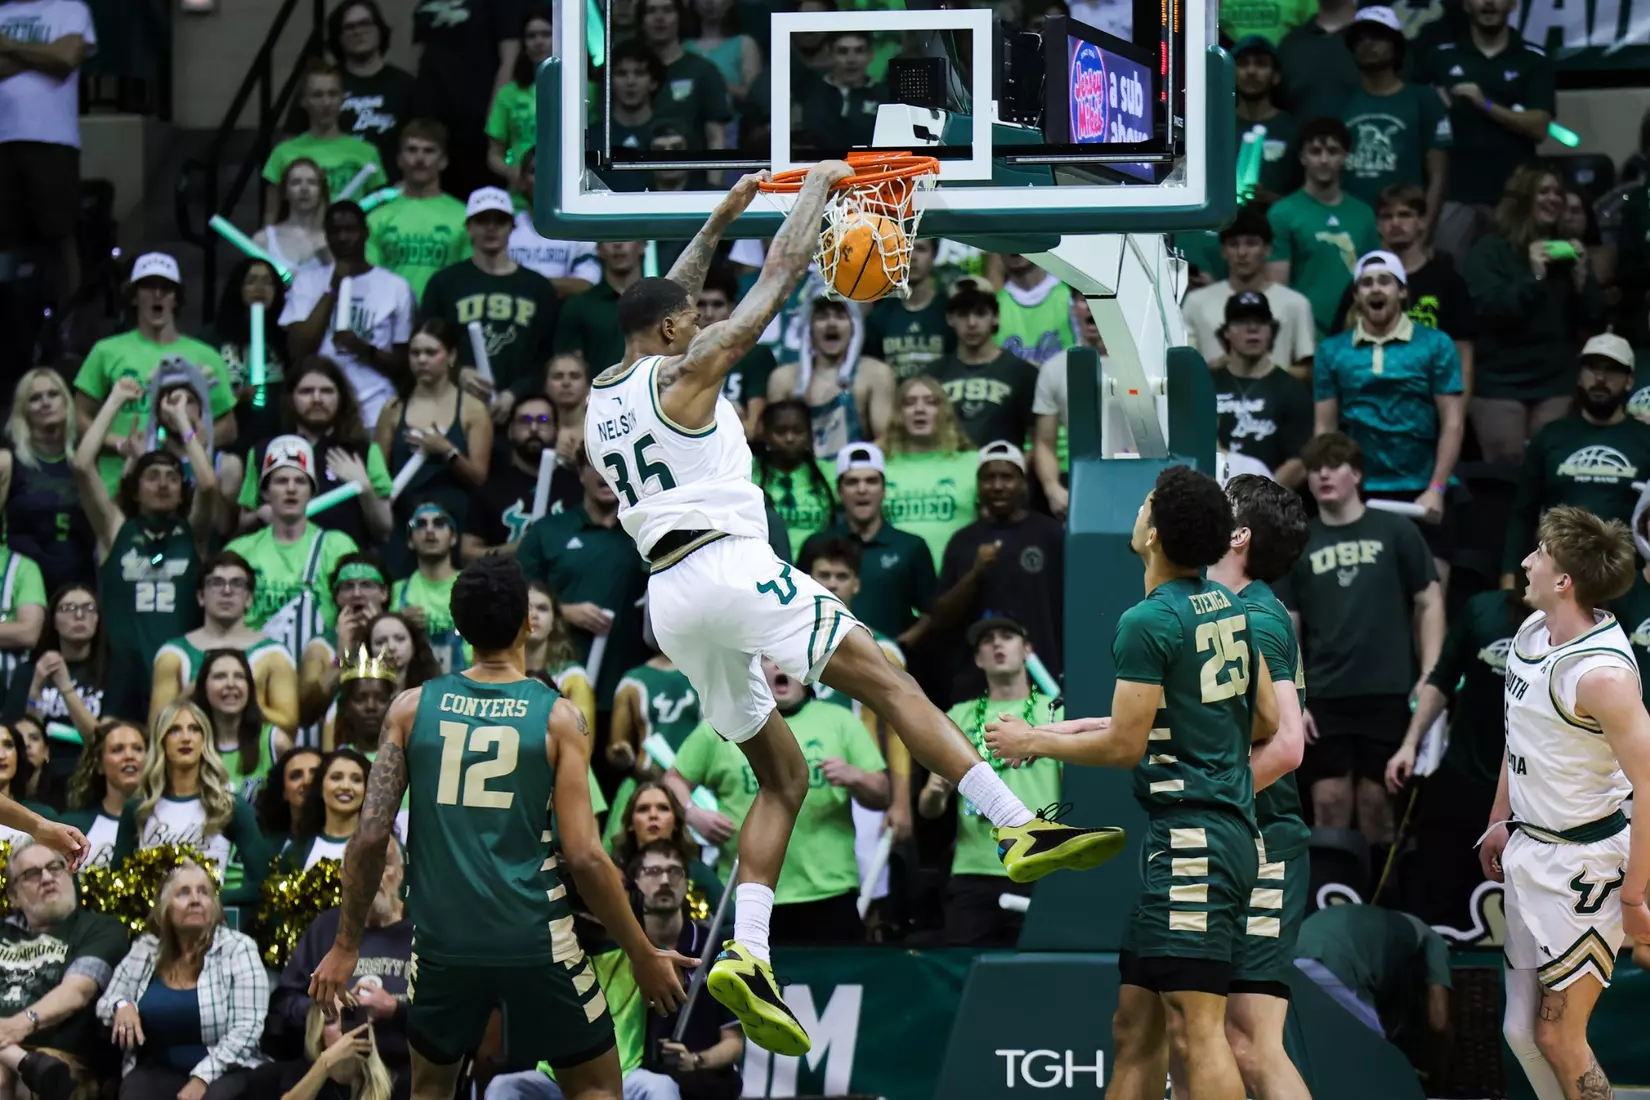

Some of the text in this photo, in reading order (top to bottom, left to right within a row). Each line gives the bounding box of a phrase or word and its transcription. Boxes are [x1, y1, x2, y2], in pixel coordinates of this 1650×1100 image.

[1109, 70, 1143, 118] a sub
[456, 293, 537, 325] USF
[1309, 539, 1384, 575] USF
[135, 581, 176, 613] 22
[1195, 613, 1250, 704] 25
[440, 692, 529, 718] CONYERS
[436, 719, 520, 810] 12
[995, 1048, 1104, 1089] TGH
